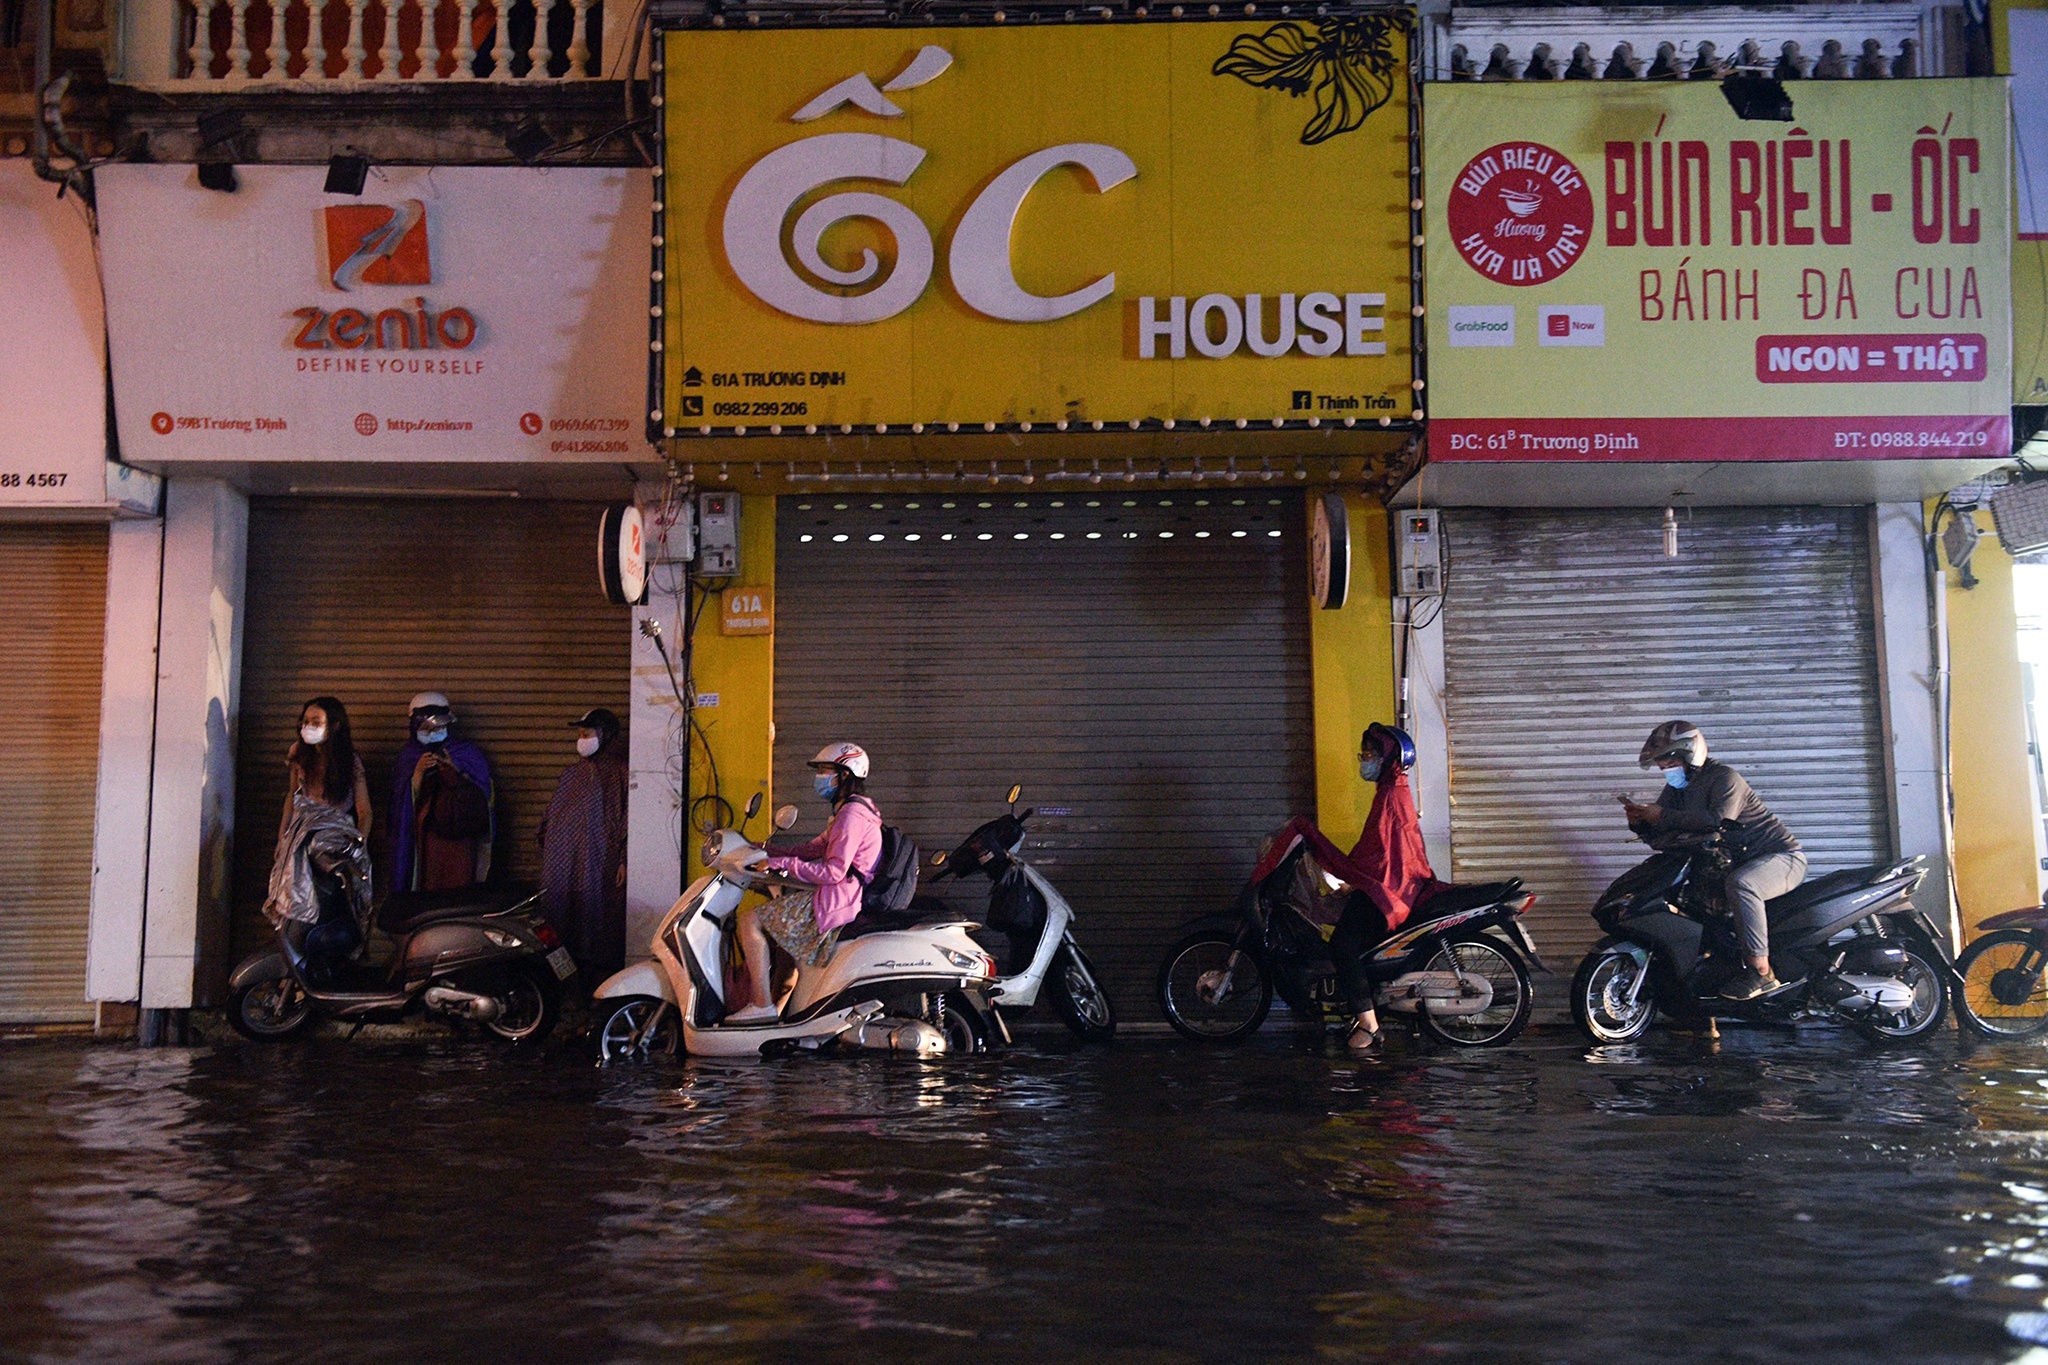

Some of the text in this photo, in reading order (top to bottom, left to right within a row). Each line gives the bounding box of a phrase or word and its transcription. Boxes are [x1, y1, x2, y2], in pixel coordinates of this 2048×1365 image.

[1501, 146, 1554, 175] RIÊU
[723, 45, 1138, 325] ỐC
[1605, 113, 1711, 247] BÚN
[1729, 126, 1852, 246] RIÊU
[1911, 112, 1981, 244] ỐC
[1640, 256, 1982, 321] BÁNH ĐA CUA
[293, 297, 476, 350] zenio
[1138, 293, 1387, 358] HOUSE
[1454, 321, 1508, 332] GrabFood
[1572, 321, 1595, 330] Now
[296, 358, 485, 375] DEFINE YOURSELF
[1768, 346, 1860, 372] NGON
[1893, 338, 1979, 377] THẬT
[712, 373, 739, 386] 61A
[713, 402, 808, 416] 0982 299 206
[1450, 434, 1483, 450] ĐC:
[1520, 433, 1589, 454] Trương
[1594, 433, 1639, 454] Định
[1834, 431, 1988, 448] ĐT: 0988.844.219
[0, 473, 68, 488] 88 4567
[731, 595, 762, 614] 61A
